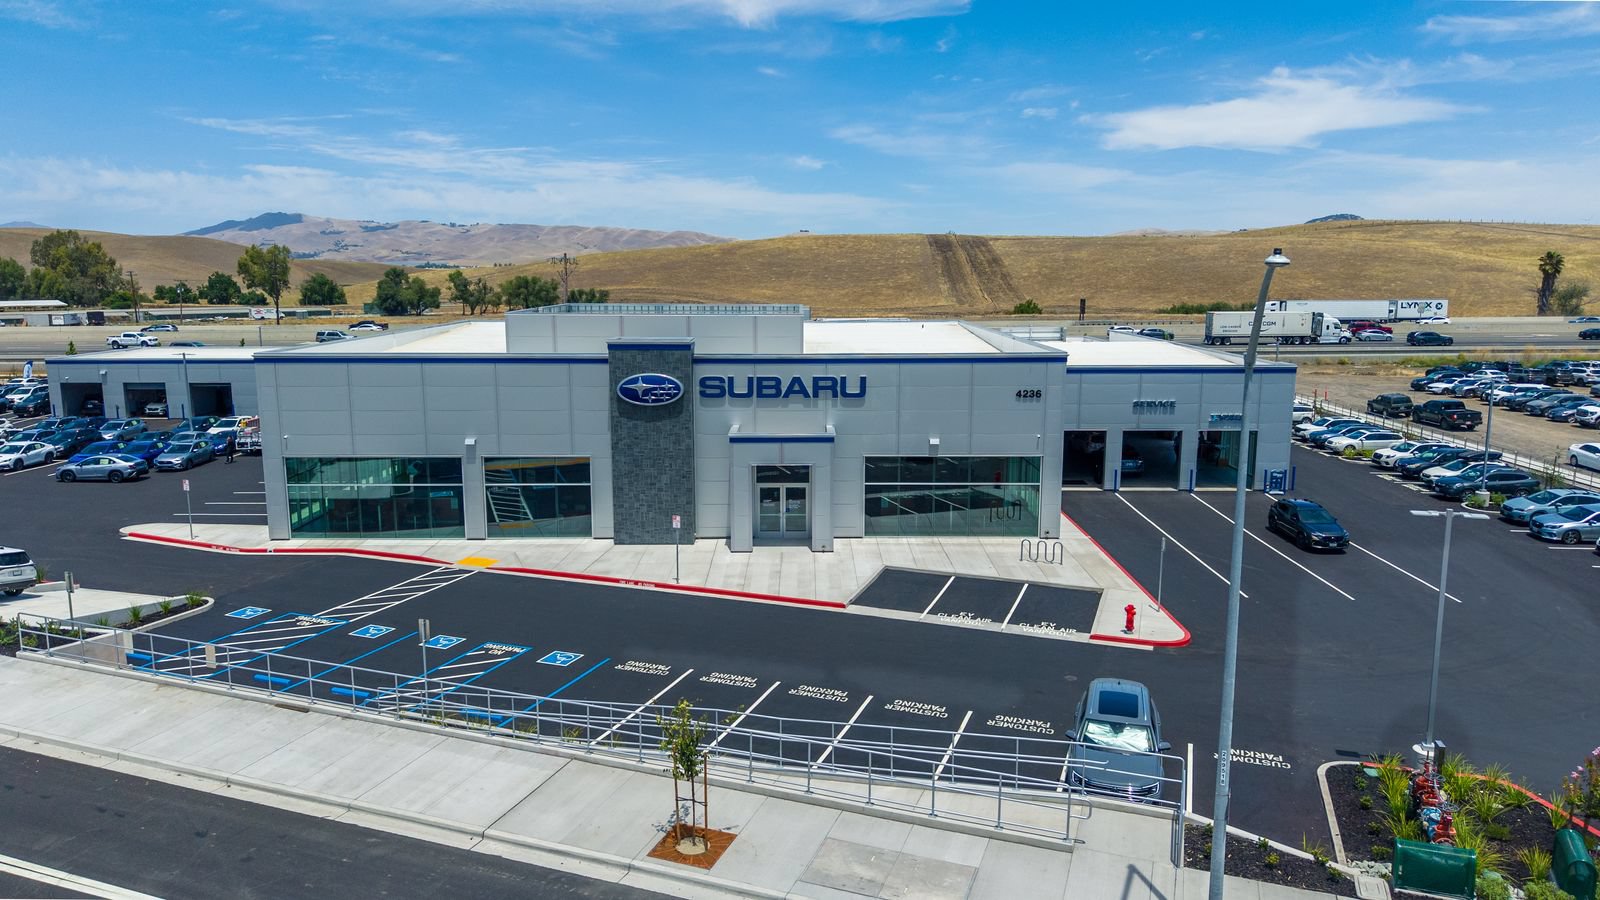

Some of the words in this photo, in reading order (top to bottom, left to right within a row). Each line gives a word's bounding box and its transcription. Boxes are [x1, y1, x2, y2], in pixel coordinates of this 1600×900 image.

[699, 375, 867, 398] SUBARU
[1016, 389, 1042, 398] 4236
[1133, 399, 1176, 408] SERVICE
[938, 612, 971, 621] CLEAN
[940, 617, 984, 626] VANPOOL
[1020, 622, 1055, 631] CLEAN
[1023, 627, 1071, 636] VANPOOL
[614, 664, 670, 676] CUSTOMER
[625, 660, 671, 671] PARKING
[700, 675, 756, 688] CUSTOMER
[710, 672, 758, 683] PARKING
[788, 688, 849, 703] CUSTOMER
[798, 684, 848, 696] PARKING
[884, 703, 948, 719] CUSTOMER
[894, 699, 946, 713] PARKING
[987, 719, 1054, 735] CUSTOMER
[995, 715, 1051, 728] PARKING
[1230, 748, 1283, 762] PARKIN
